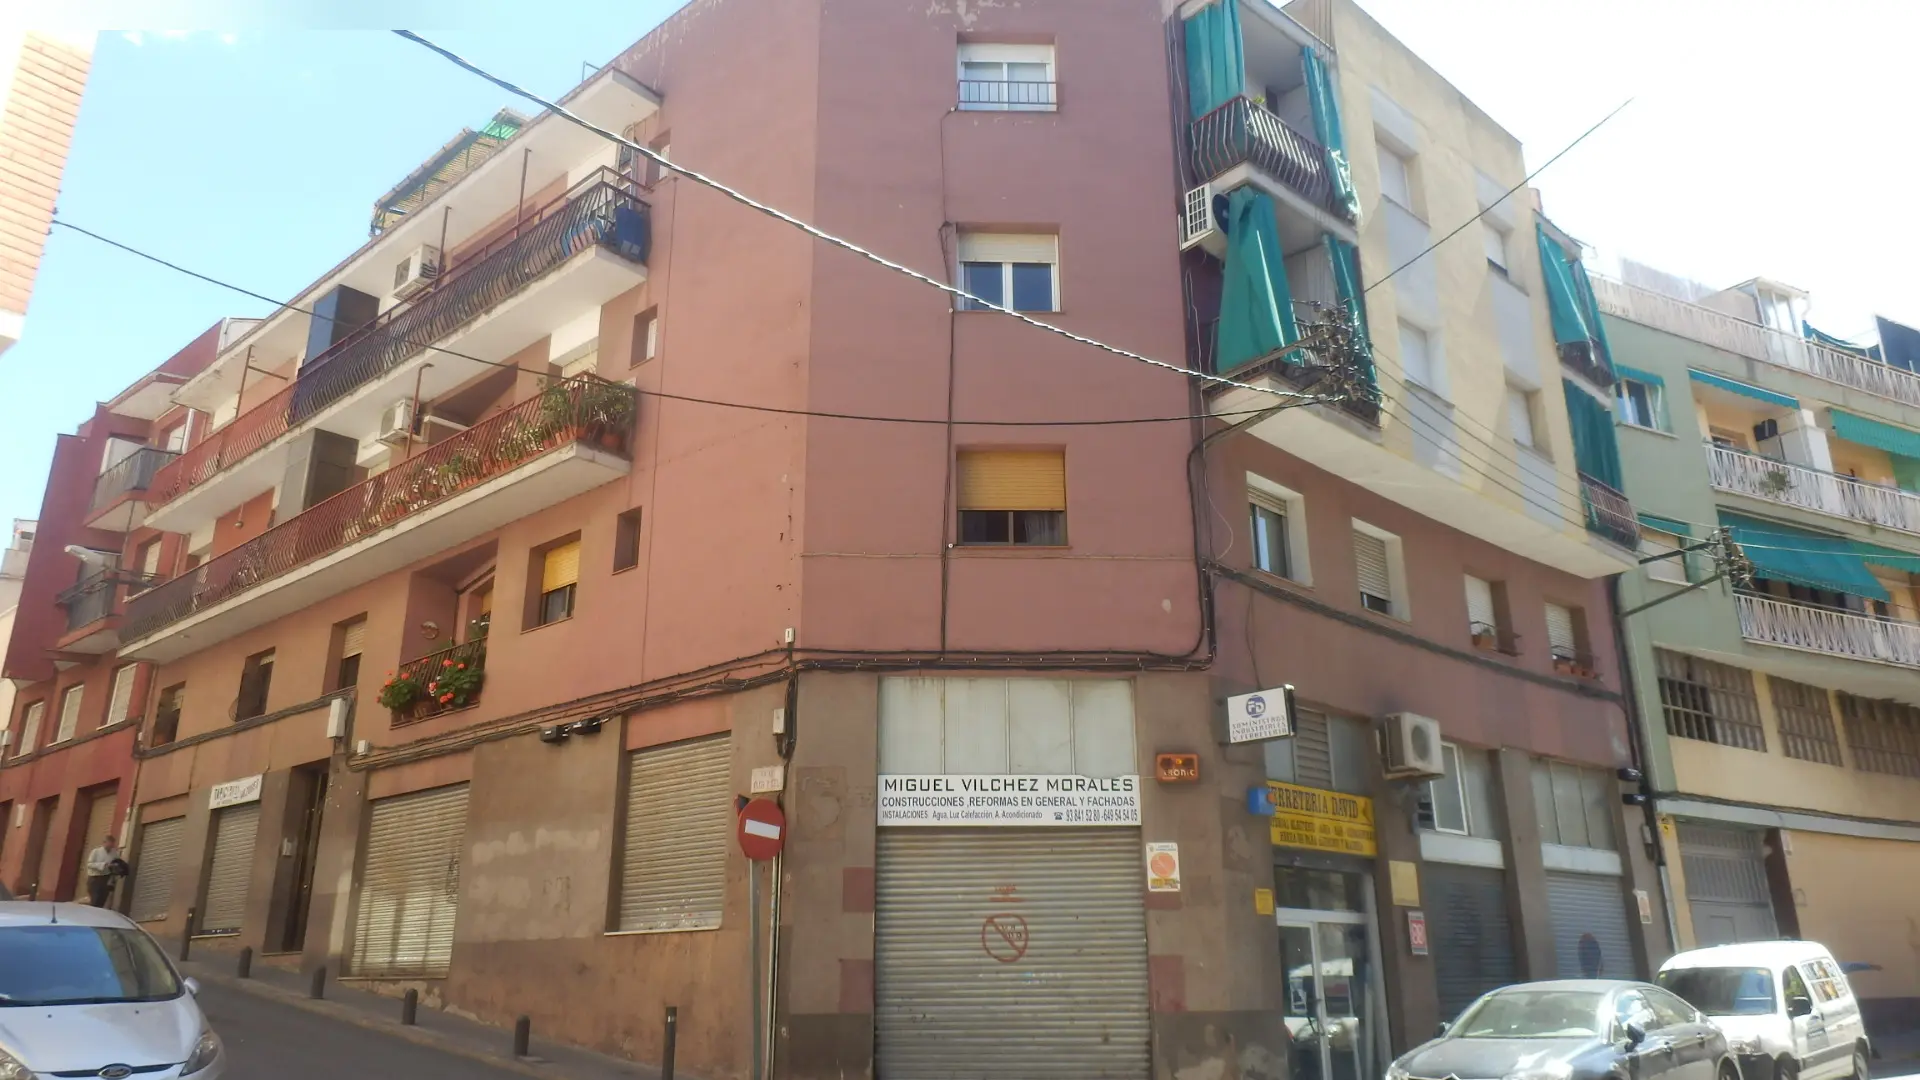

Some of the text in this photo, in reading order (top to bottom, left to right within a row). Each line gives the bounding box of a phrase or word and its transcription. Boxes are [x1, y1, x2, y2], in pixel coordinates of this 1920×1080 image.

[884, 778, 1133, 792] MIGUEL VILCHEZ MORALES
[881, 796, 964, 807] CONSTRUCCIONES
[1021, 796, 1033, 807] EN
[1035, 796, 1077, 807] GENERAL
[1079, 796, 1085, 807] Y
[1087, 796, 1135, 807] FACHADAS
[1268, 785, 1359, 819] ERRETERIA DAVID
[882, 810, 928, 819] INSTALACIONES
[1066, 809, 1073, 822] 93
